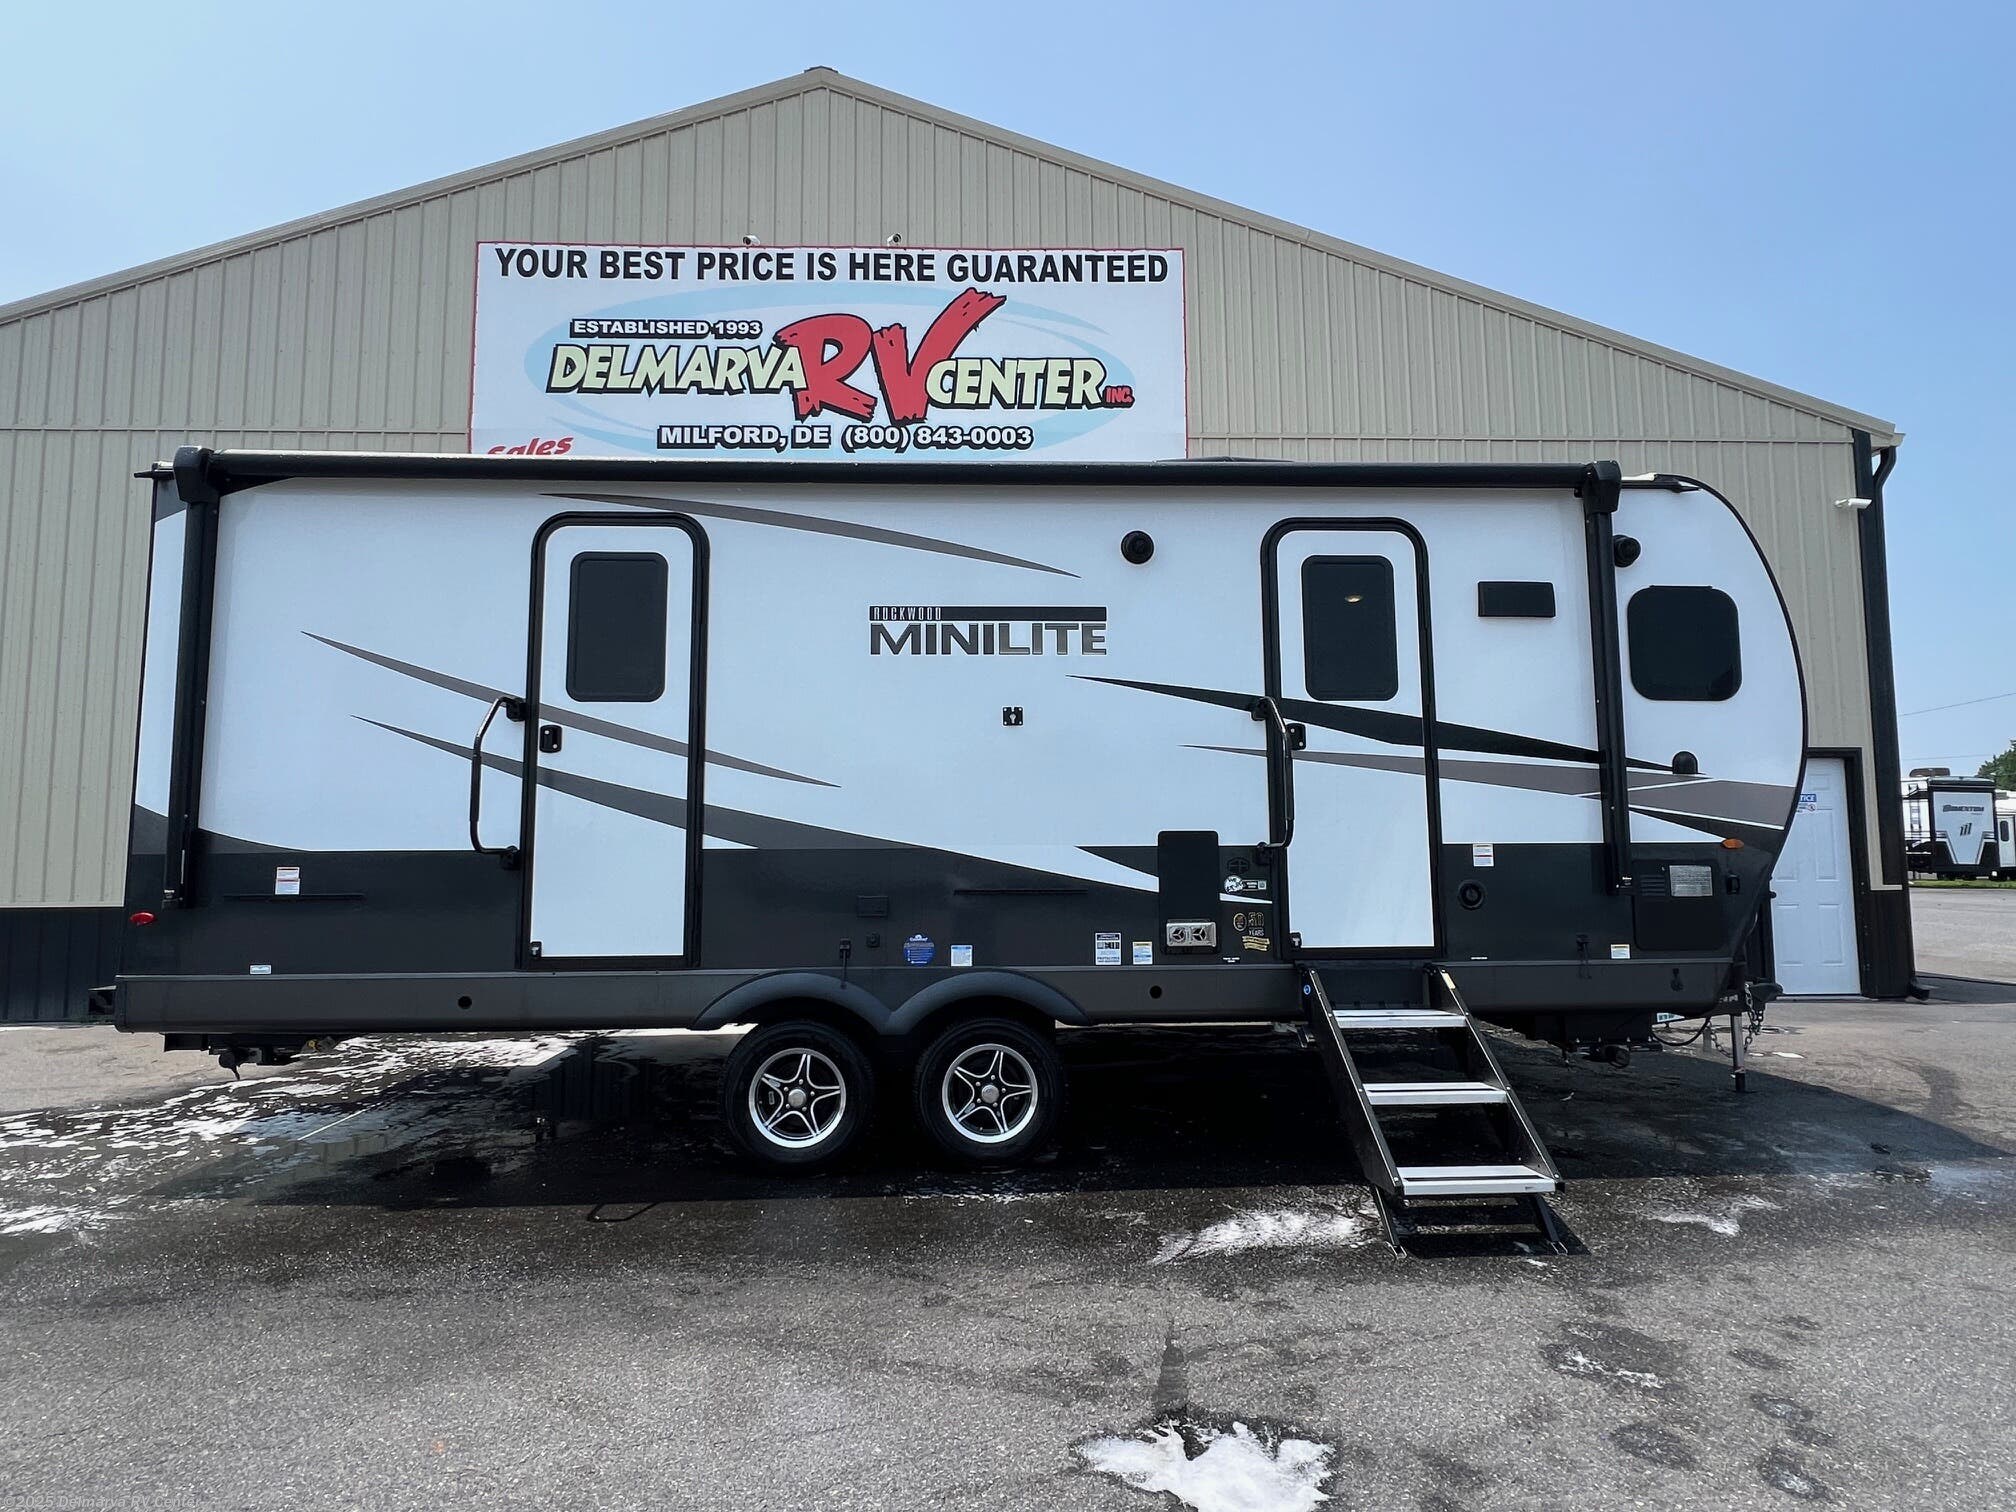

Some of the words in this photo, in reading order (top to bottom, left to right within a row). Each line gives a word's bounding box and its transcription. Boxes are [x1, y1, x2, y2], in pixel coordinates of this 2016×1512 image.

[496, 247, 588, 279] YOUR
[601, 251, 685, 281] BEST
[698, 251, 794, 281] PRICE
[806, 252, 836, 281] IS
[849, 252, 935, 282] HERE
[946, 253, 1168, 283] GUARANTEED
[572, 320, 709, 337] ESTABLISHED
[714, 321, 763, 337] 1993
[549, 344, 808, 394] DELMARVA
[773, 287, 1007, 425] RV
[925, 358, 1106, 408] CENTER
[659, 424, 786, 449] MILFORD,
[793, 426, 831, 447] DE
[842, 425, 910, 449] (800)
[916, 425, 1034, 448] 843-0003
[873, 607, 942, 621] ROCKWOOD
[870, 623, 1107, 655] MINILITE
